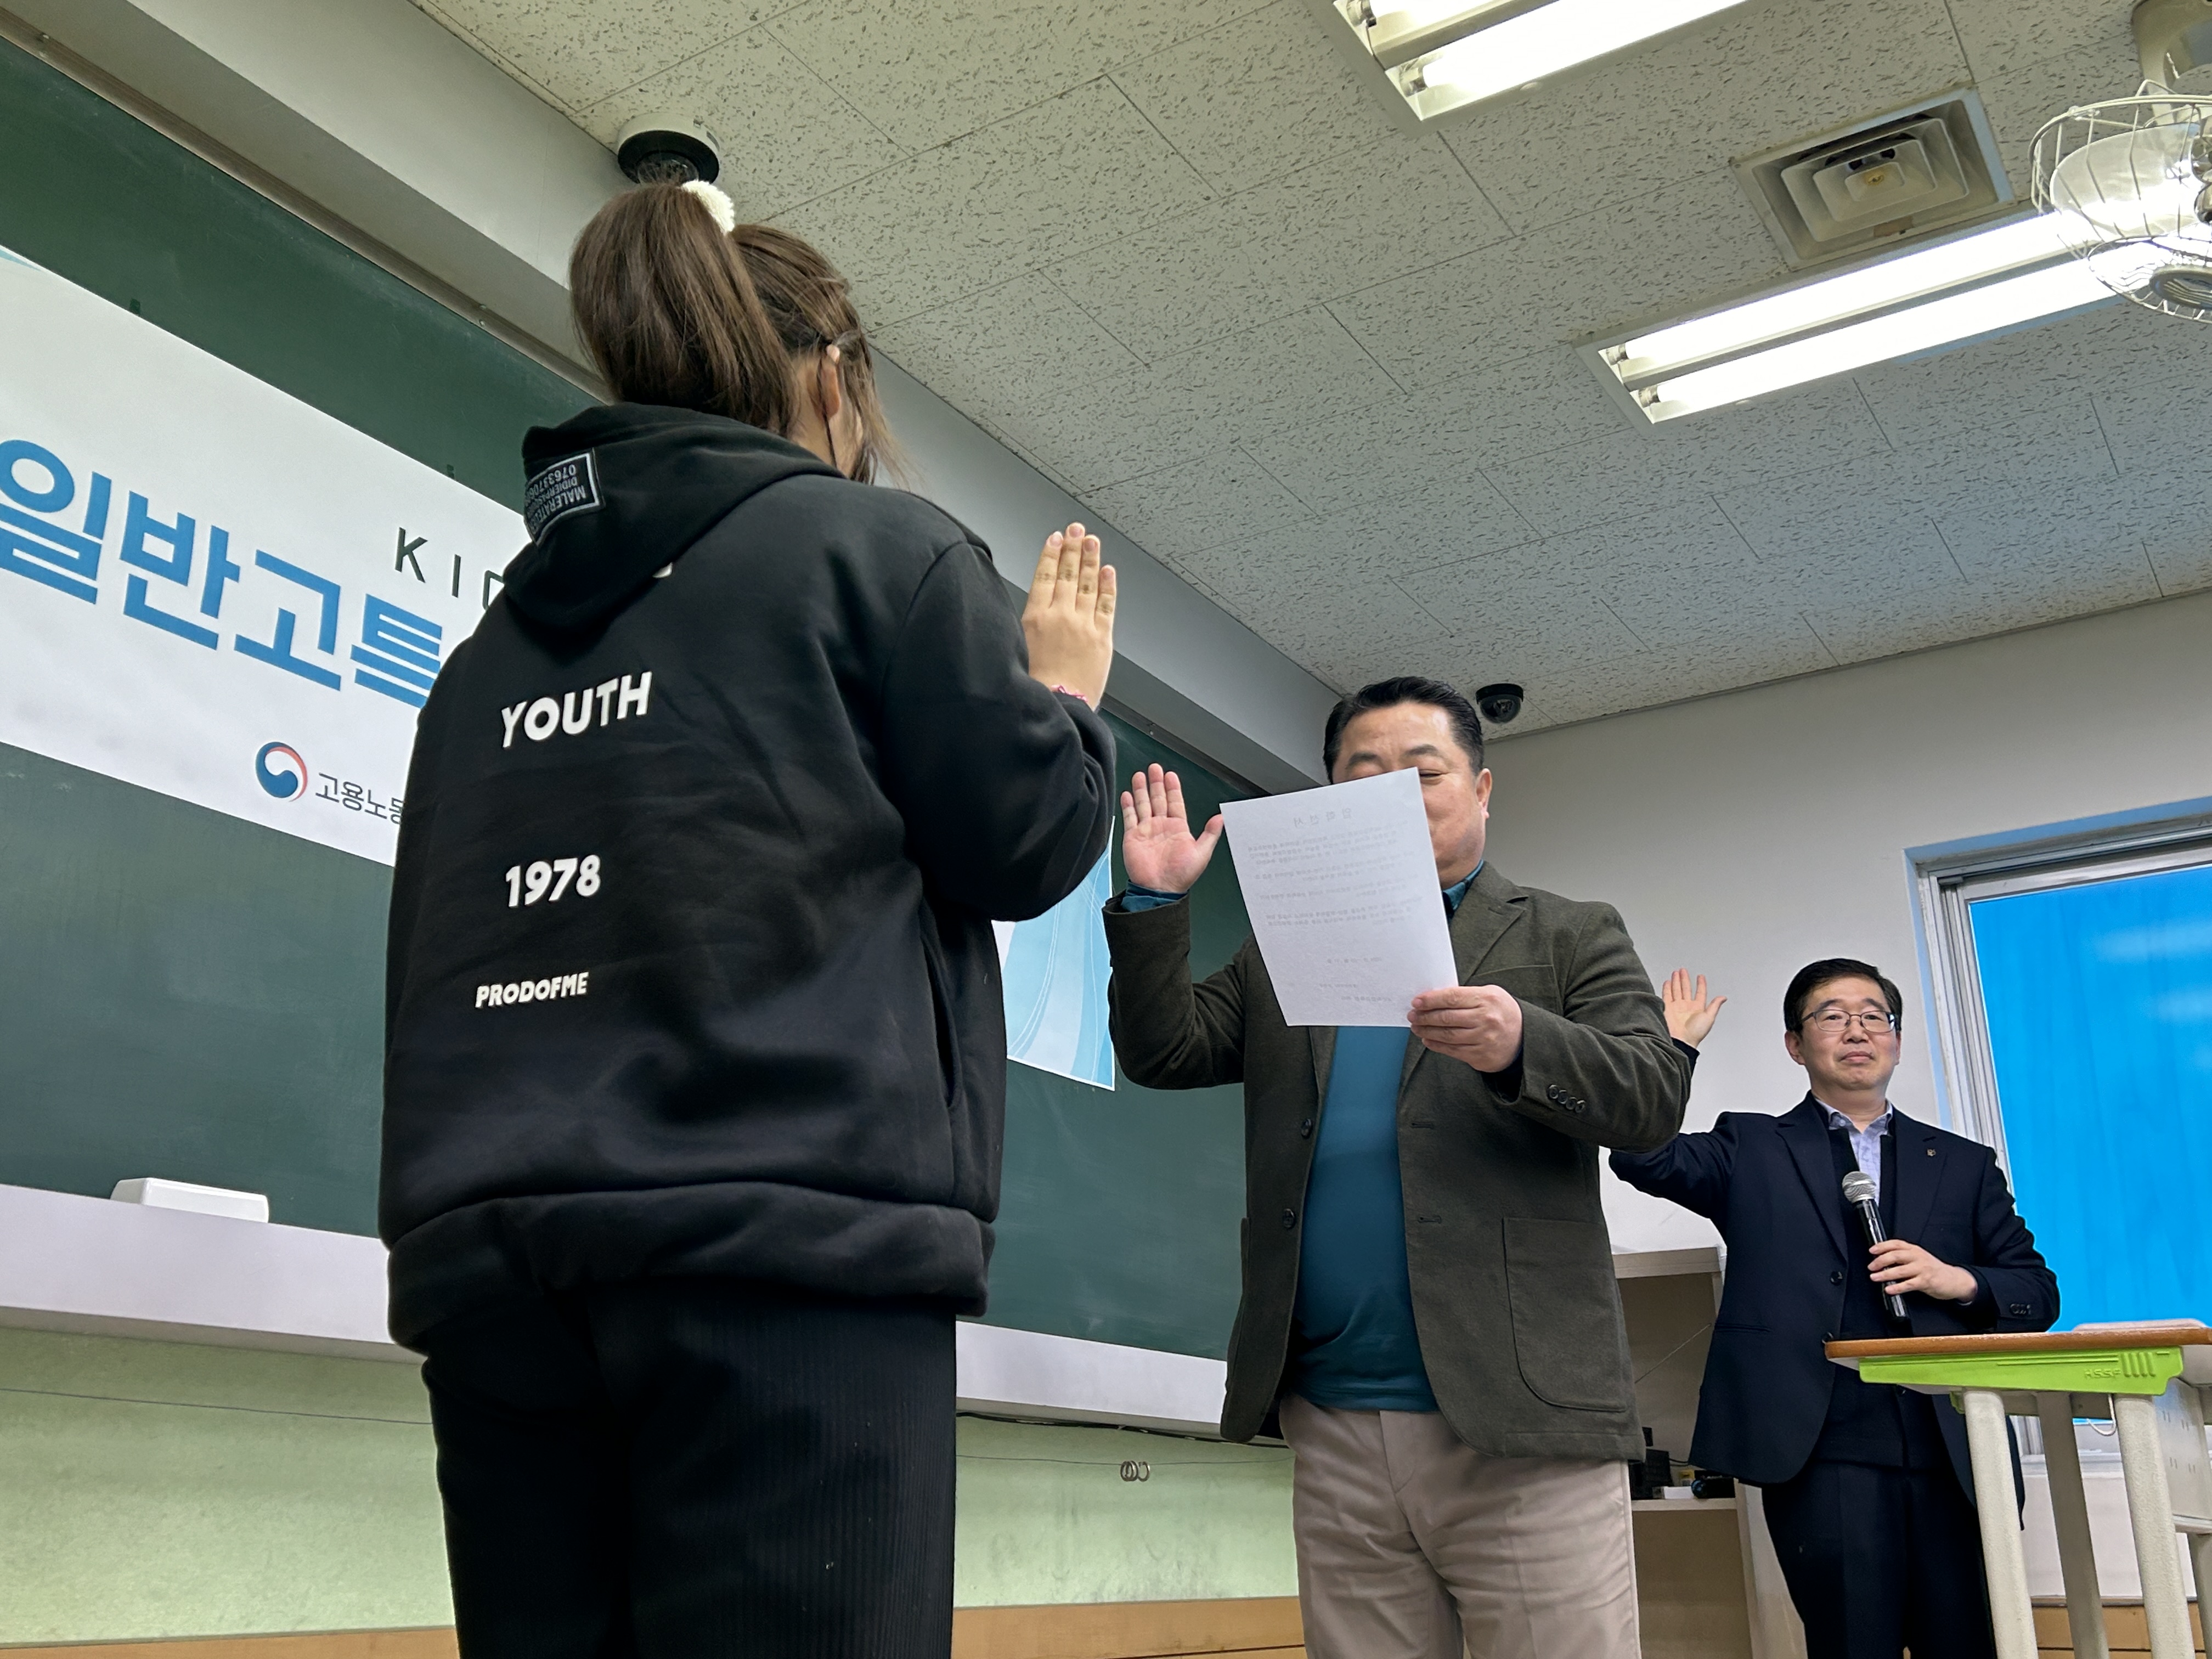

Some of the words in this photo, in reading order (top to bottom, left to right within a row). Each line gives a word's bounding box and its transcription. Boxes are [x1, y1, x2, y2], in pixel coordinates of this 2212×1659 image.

[501, 671, 652, 748] YOUTH
[505, 854, 601, 907] 1978
[475, 972, 589, 1008] PRODOFME
